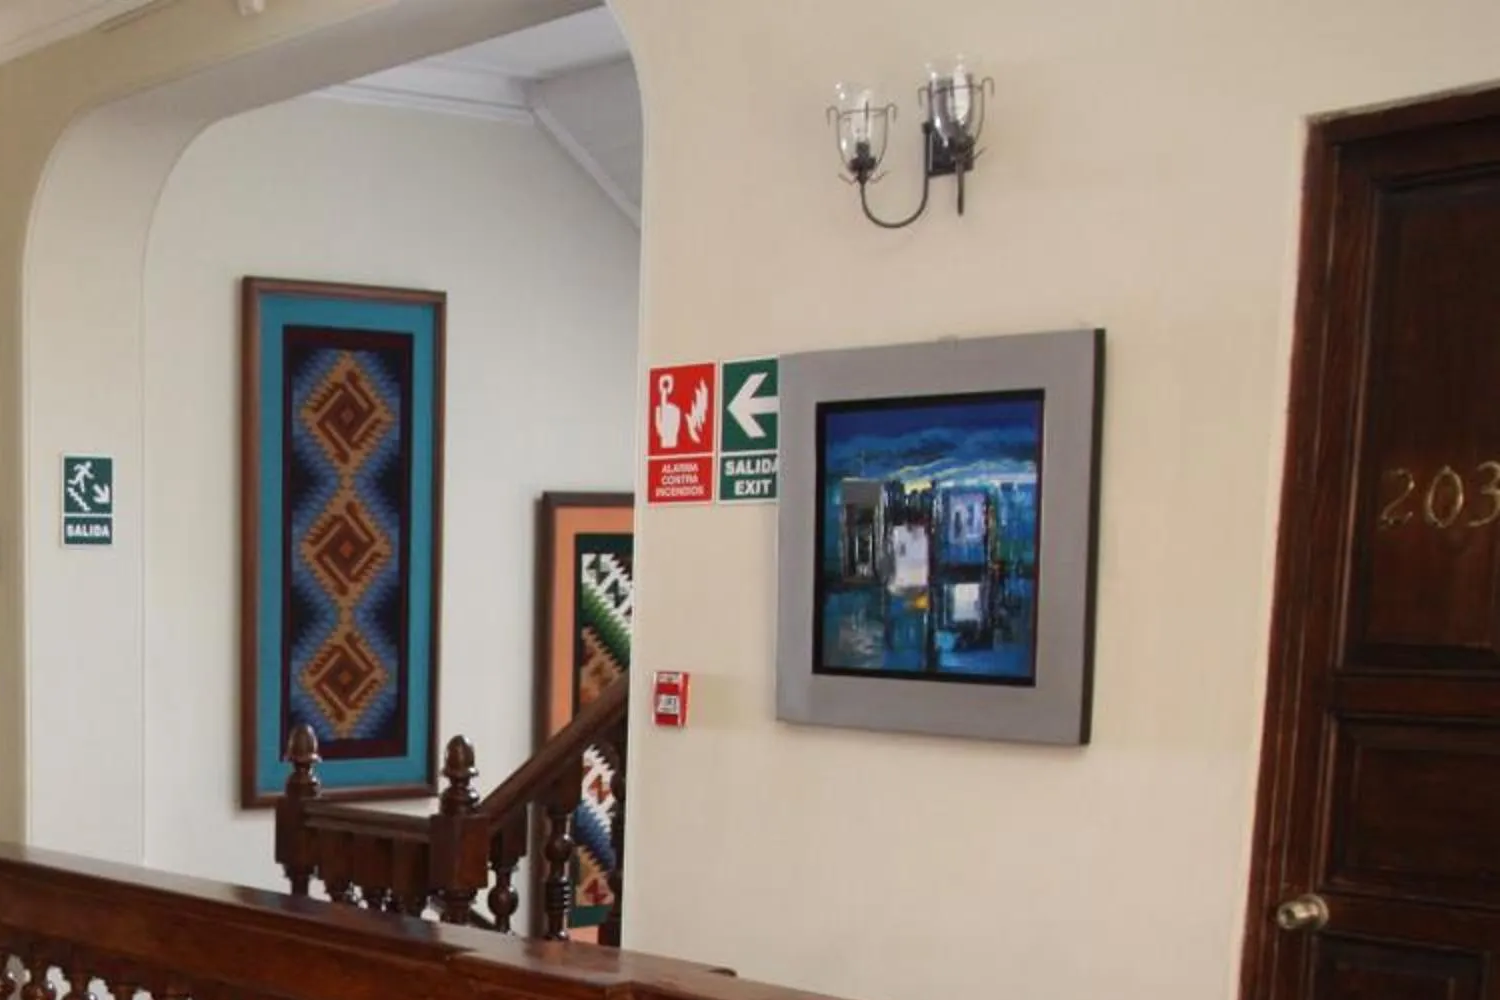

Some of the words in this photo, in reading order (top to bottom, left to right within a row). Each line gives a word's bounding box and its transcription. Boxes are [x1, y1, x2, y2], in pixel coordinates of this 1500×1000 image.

[661, 462, 699, 474] ALARMA
[661, 473, 699, 486] CONTRA
[656, 485, 705, 497] INCENDIOS
[734, 479, 772, 496] EXIT
[1379, 461, 1500, 530] 203
[66, 525, 110, 537] SALIDA
